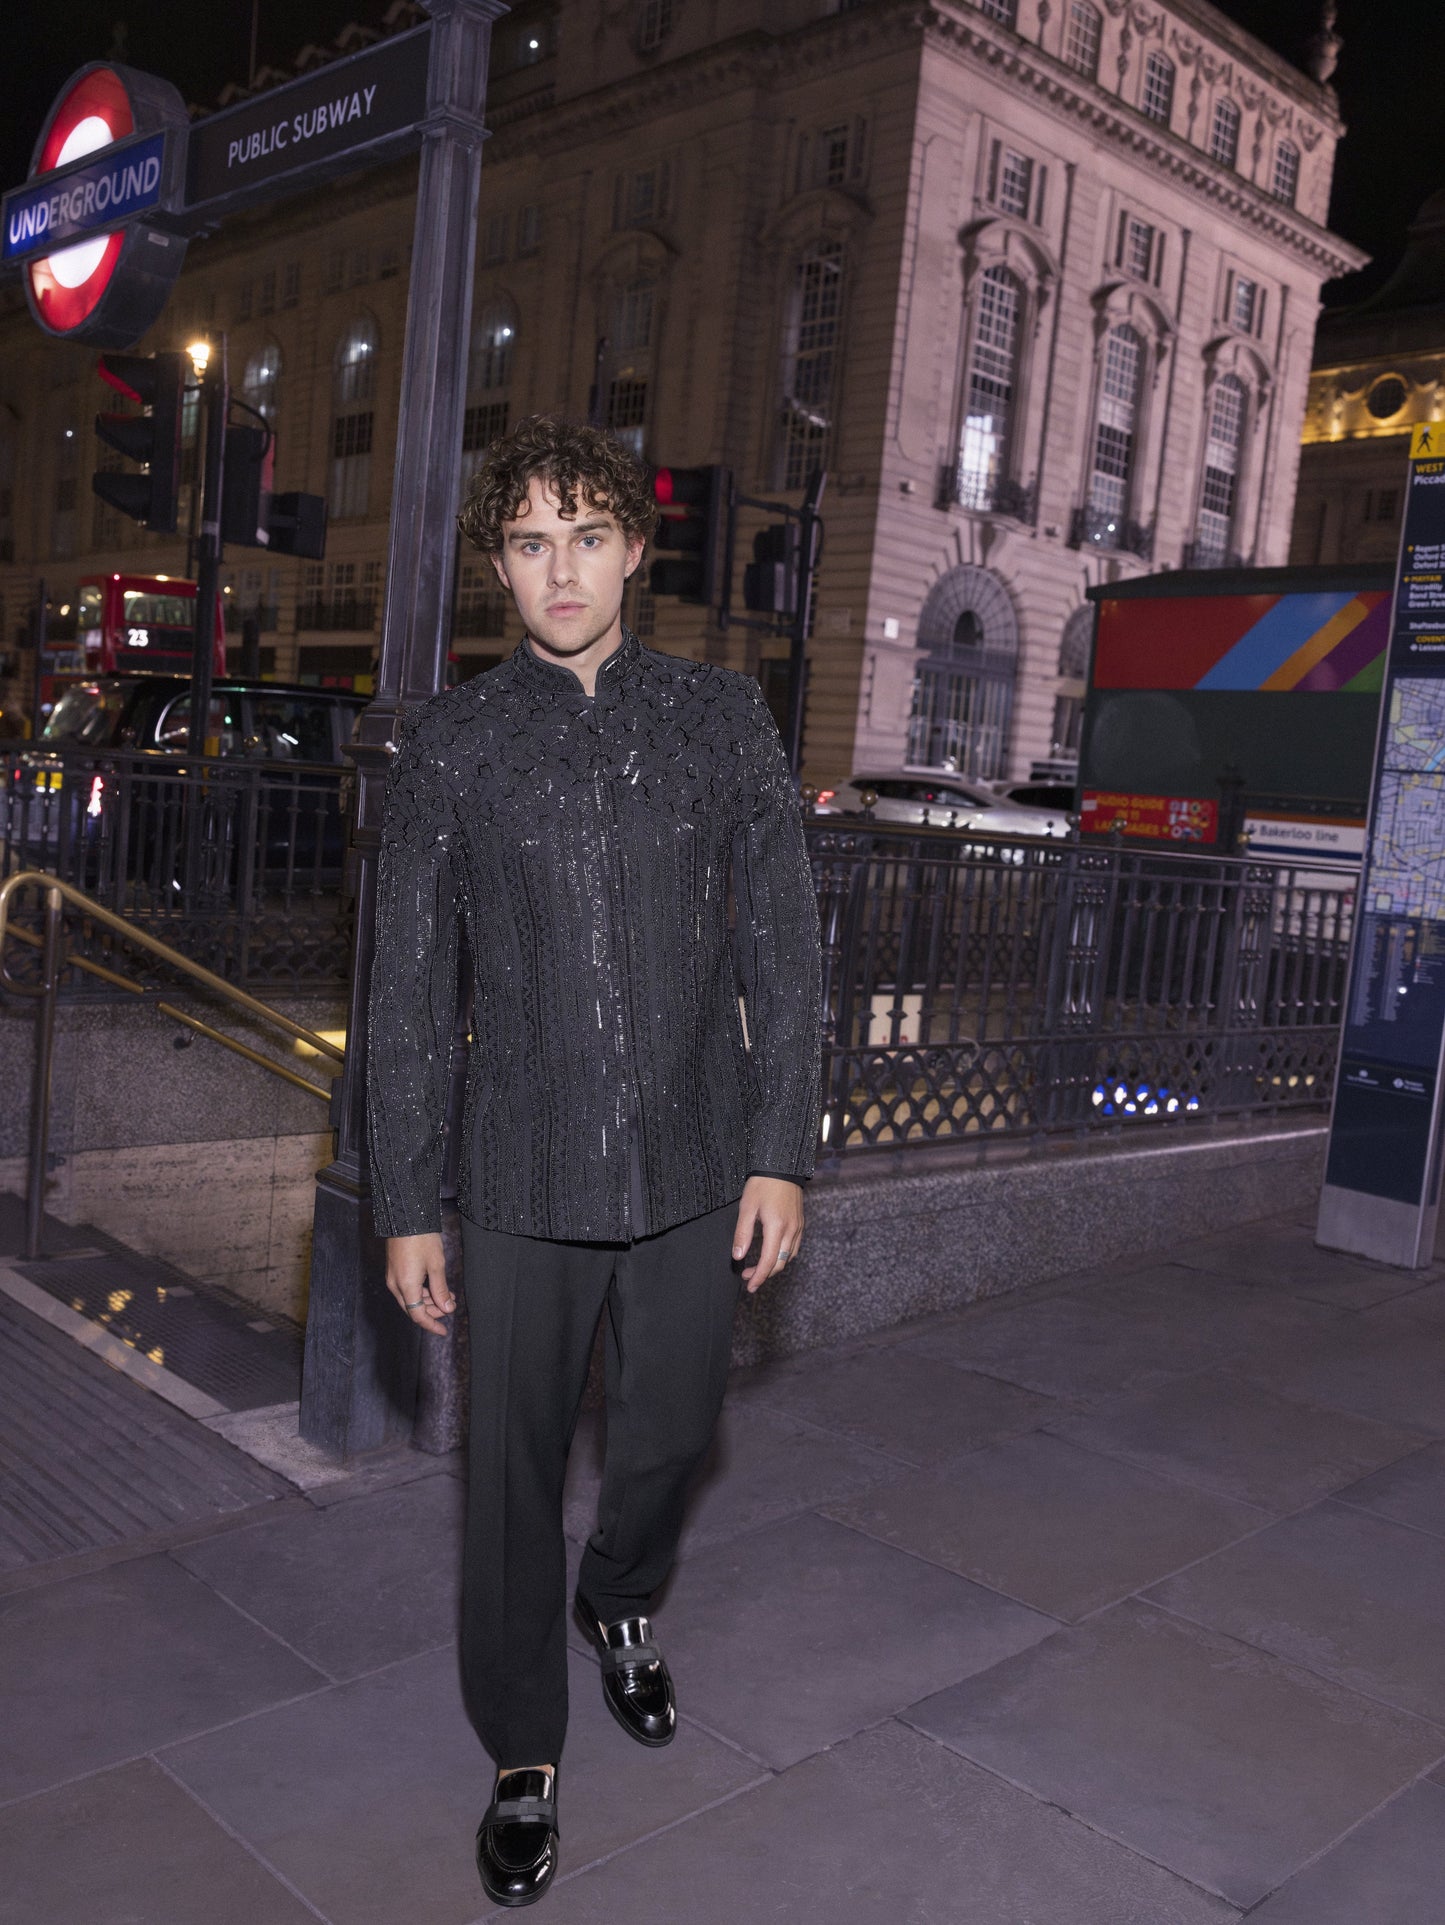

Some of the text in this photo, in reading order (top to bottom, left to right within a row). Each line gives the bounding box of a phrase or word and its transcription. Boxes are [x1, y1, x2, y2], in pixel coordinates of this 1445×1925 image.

[227, 85, 377, 168] PUBLIC SUBWAY
[9, 156, 161, 245] UNDERGROUND
[1415, 462, 1444, 474] WEST
[1412, 561, 1438, 570] Oxford
[1413, 553, 1439, 561] Oxford
[128, 628, 149, 647] 23
[1260, 825, 1340, 843] Bakerloo line
